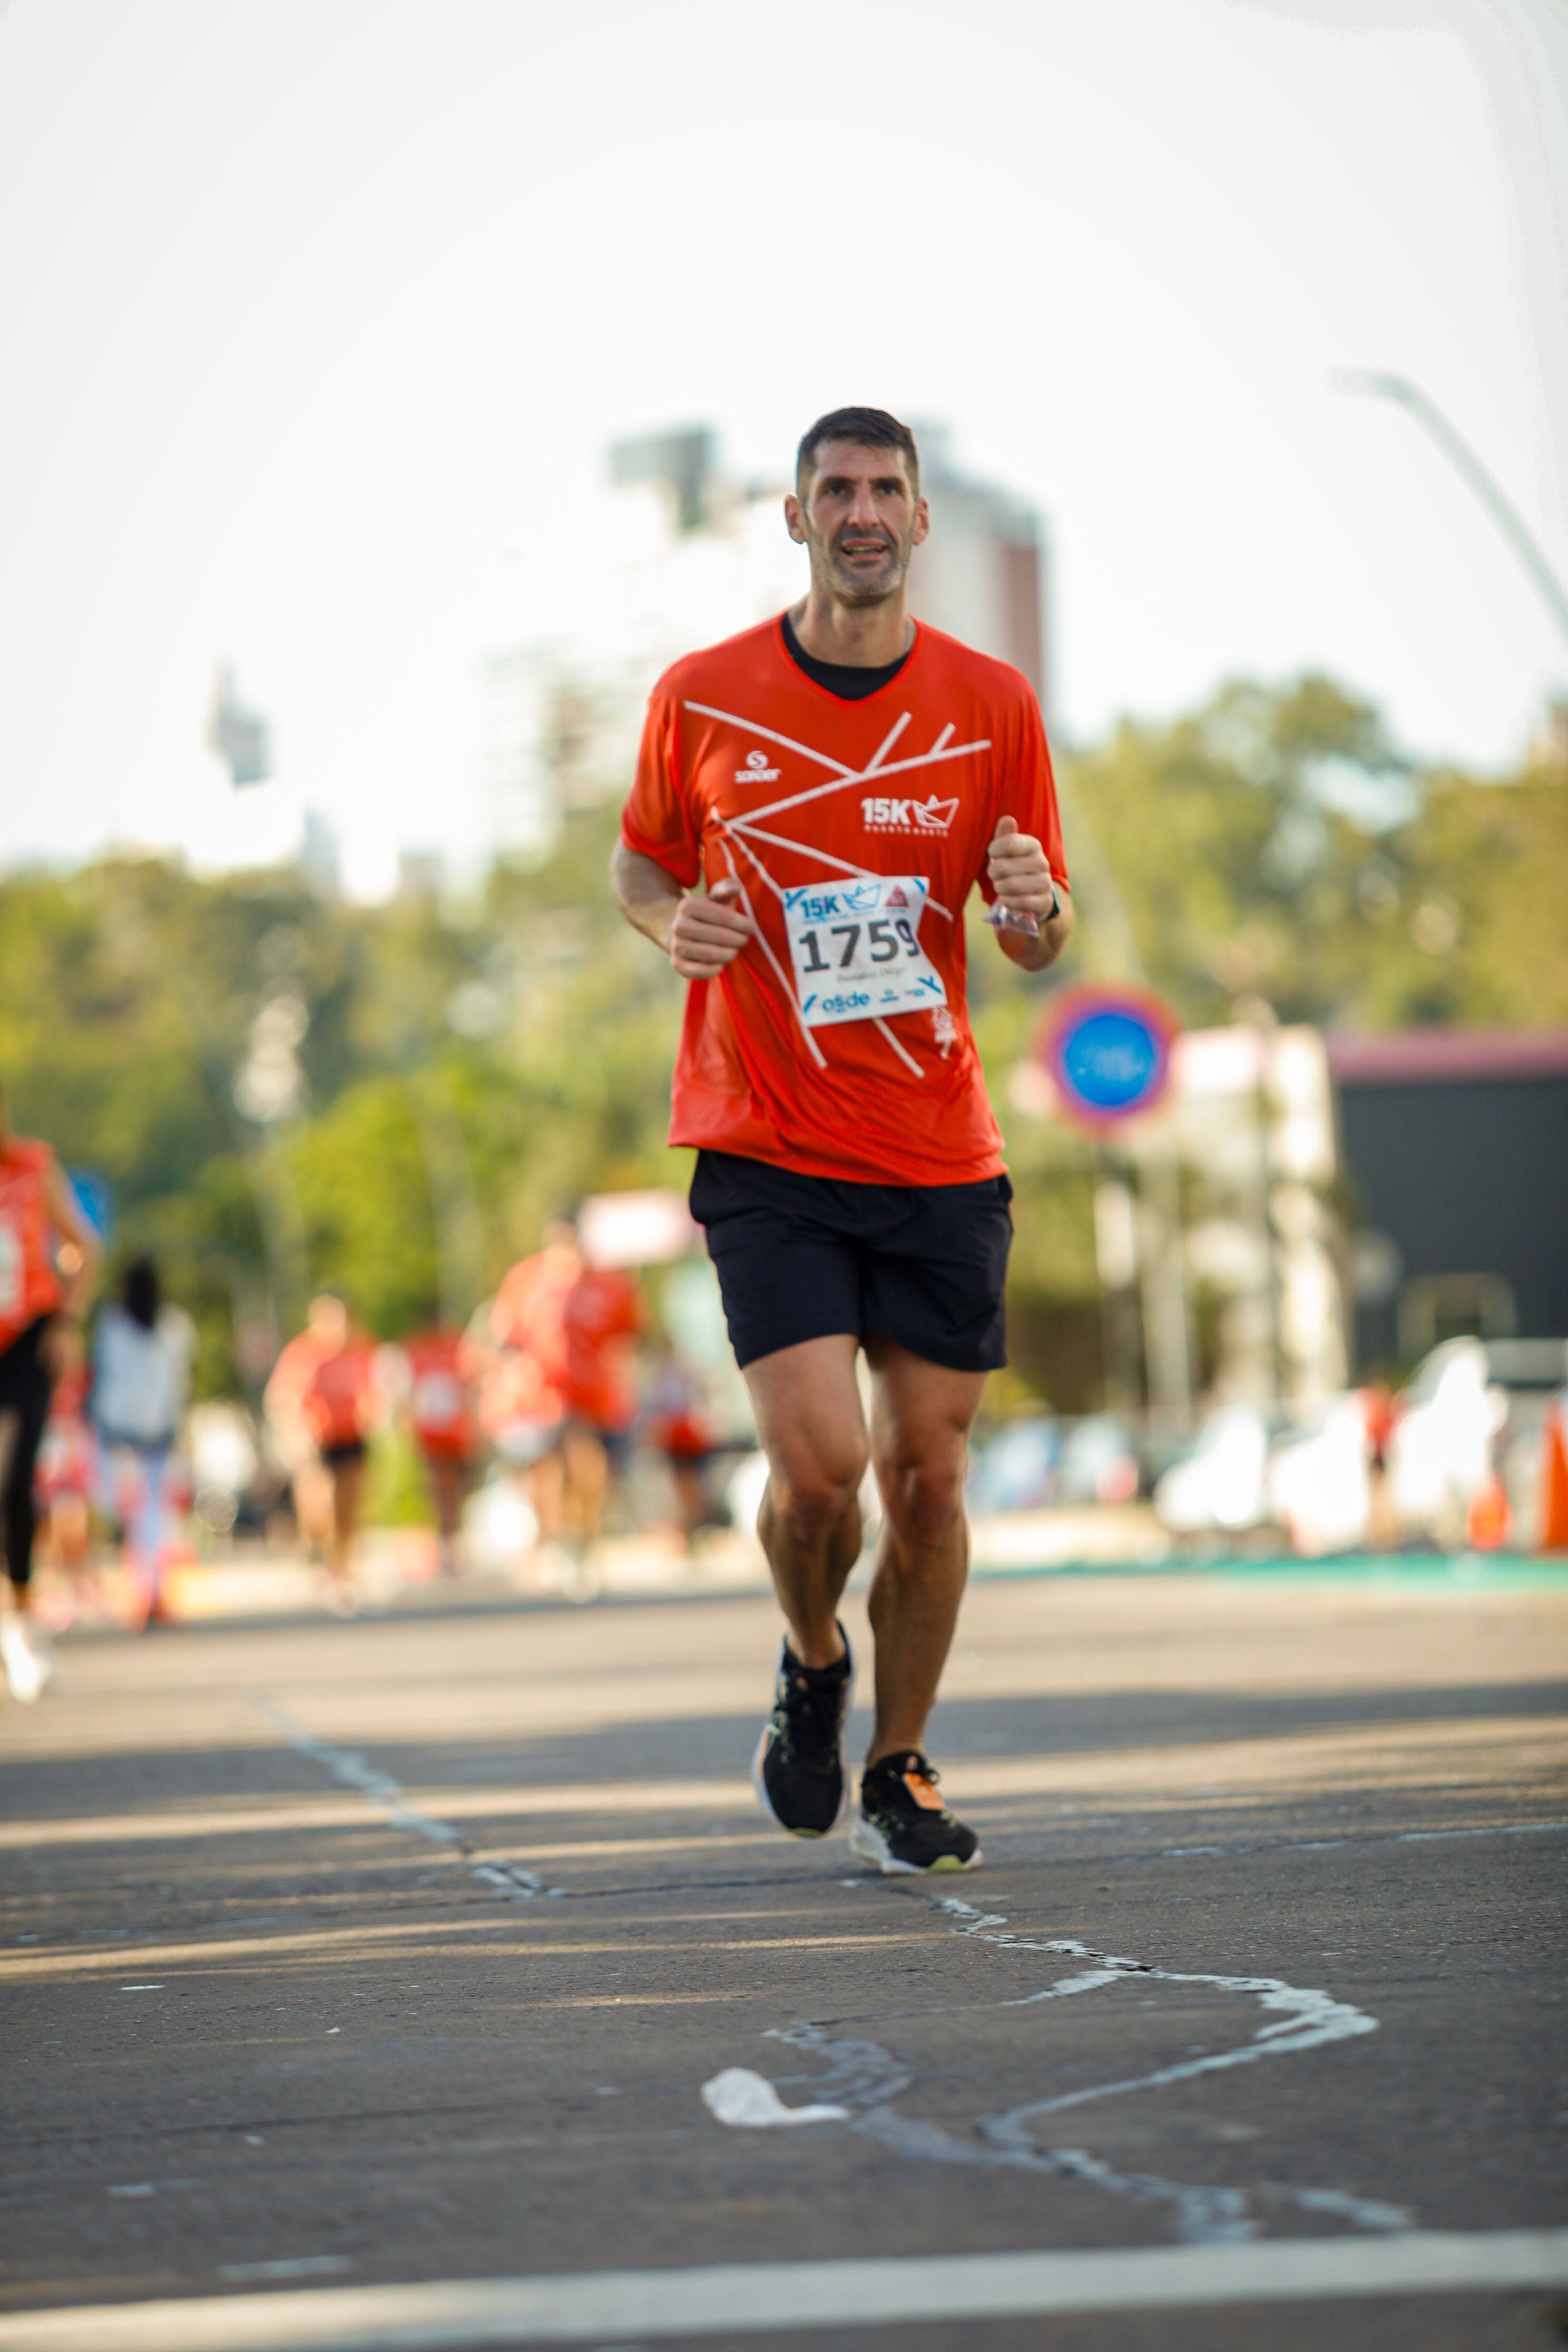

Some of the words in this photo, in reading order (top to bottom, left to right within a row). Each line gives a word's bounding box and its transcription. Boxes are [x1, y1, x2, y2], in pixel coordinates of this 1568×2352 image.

[861, 798, 911, 826] 15K
[800, 896, 840, 917] 15K
[799, 918, 919, 972] 1759
